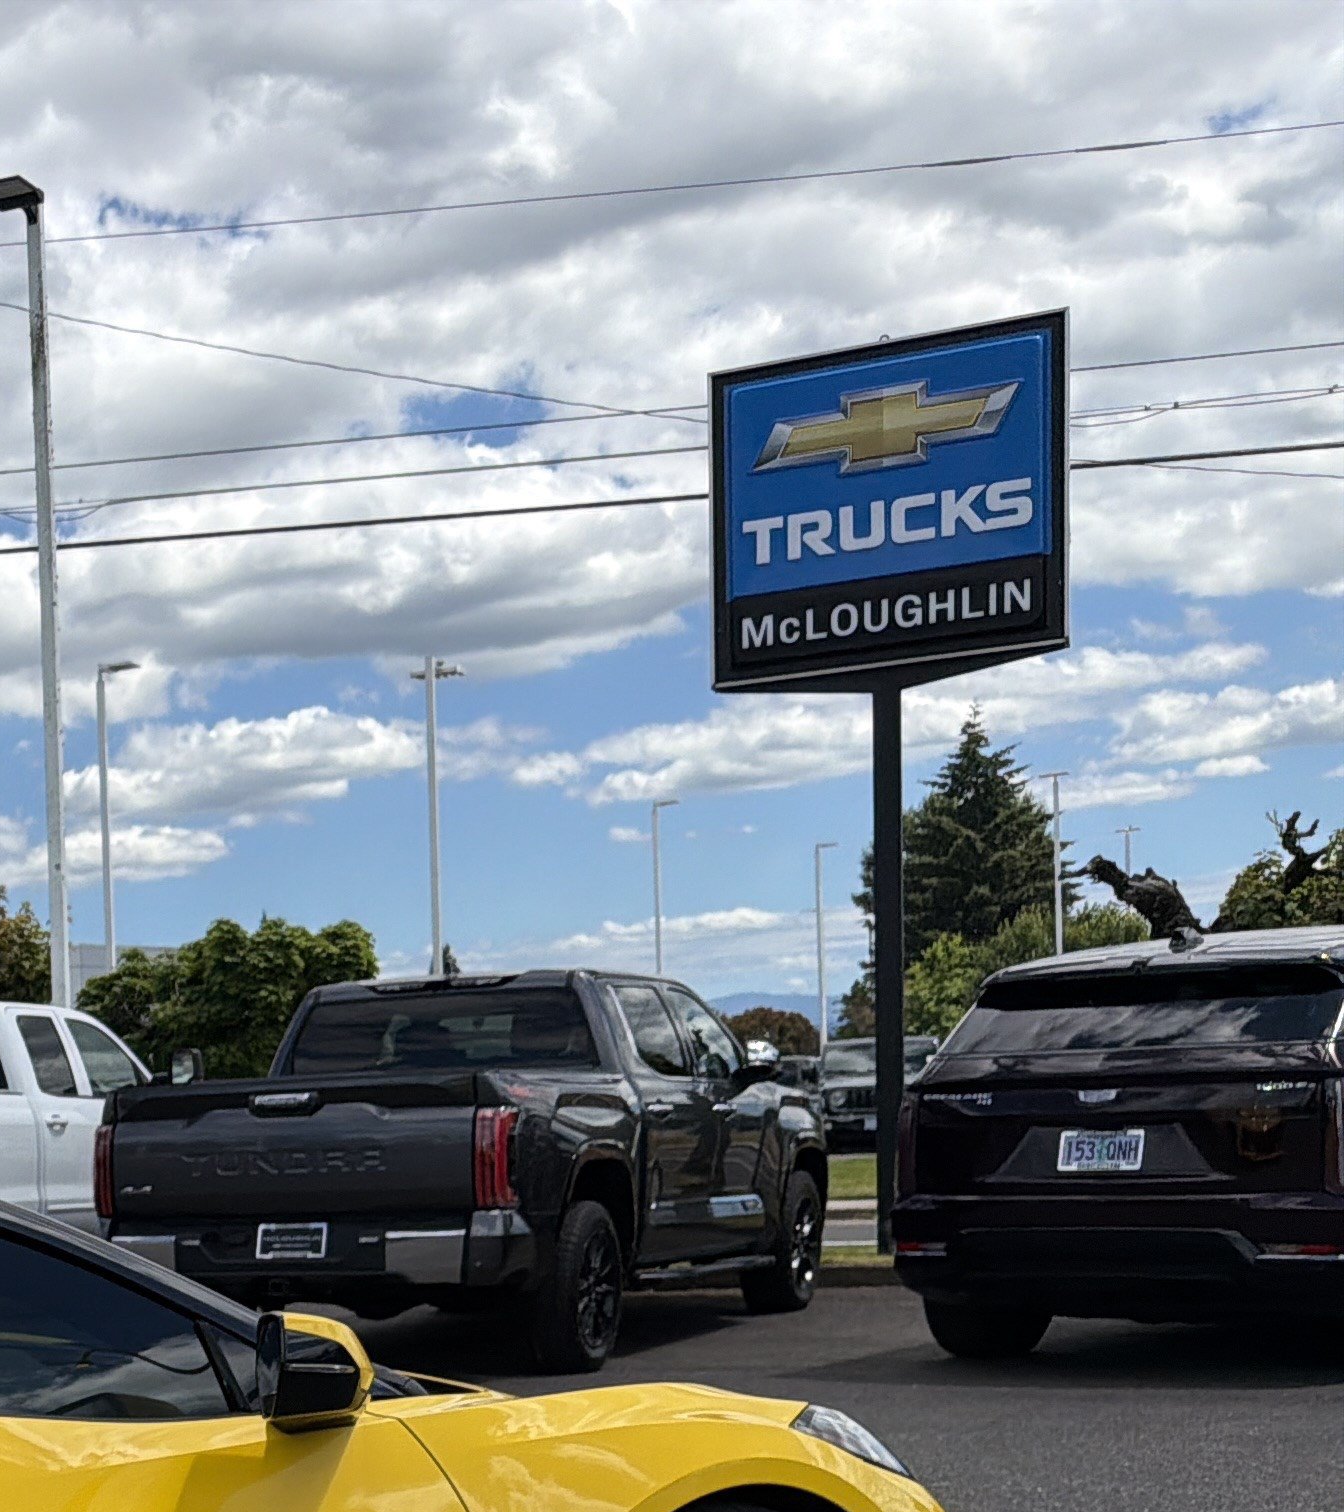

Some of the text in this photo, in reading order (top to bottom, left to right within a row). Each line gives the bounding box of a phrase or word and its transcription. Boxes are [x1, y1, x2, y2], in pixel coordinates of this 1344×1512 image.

[742, 477, 1033, 566] TRUCKS
[741, 578, 1031, 649] McLOUGHLIN
[180, 1151, 387, 1177] TUNDRA
